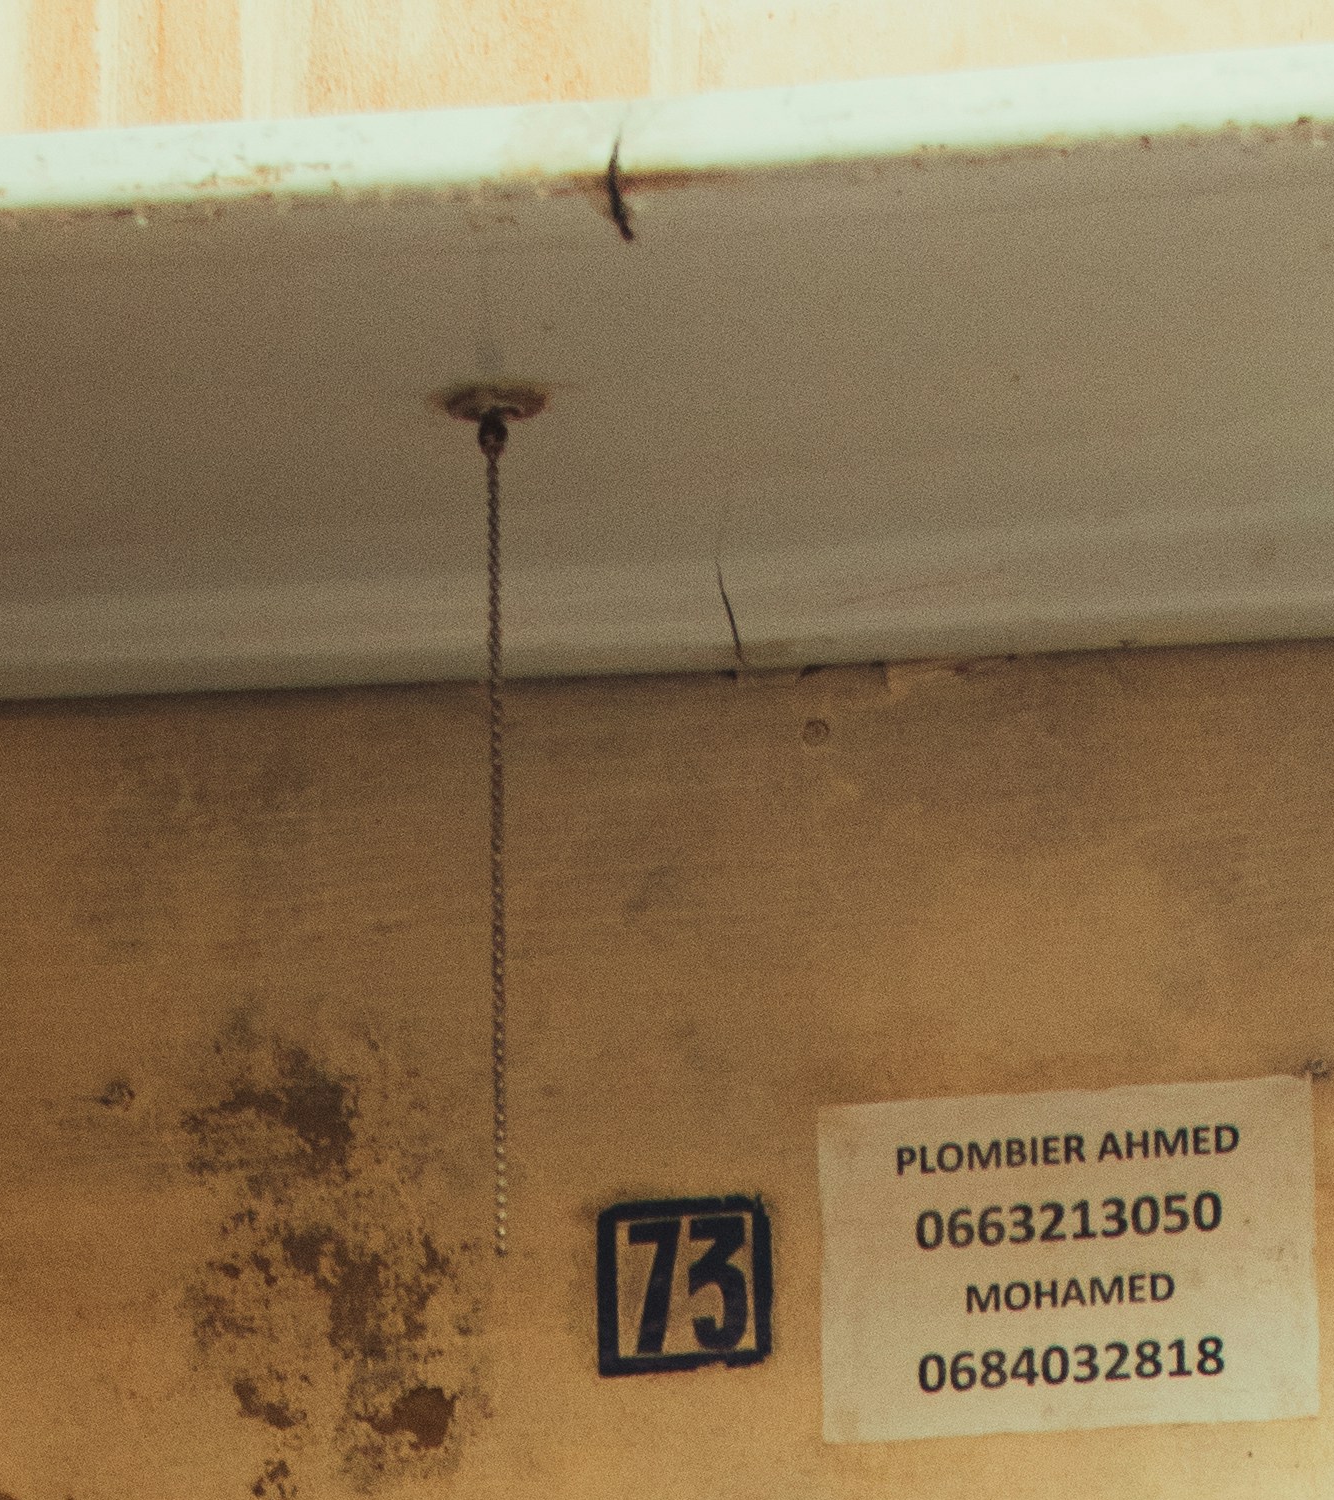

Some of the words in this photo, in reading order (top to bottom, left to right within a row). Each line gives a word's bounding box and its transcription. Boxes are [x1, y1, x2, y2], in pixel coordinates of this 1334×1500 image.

[895, 1132, 1086, 1176] PLOMBIER
[1097, 1123, 1240, 1163] AHMED
[915, 1190, 1223, 1250] 0663213050
[628, 1216, 748, 1355] 73
[965, 1271, 1175, 1314] MOHAMED
[917, 1334, 1225, 1393] 0684032818
